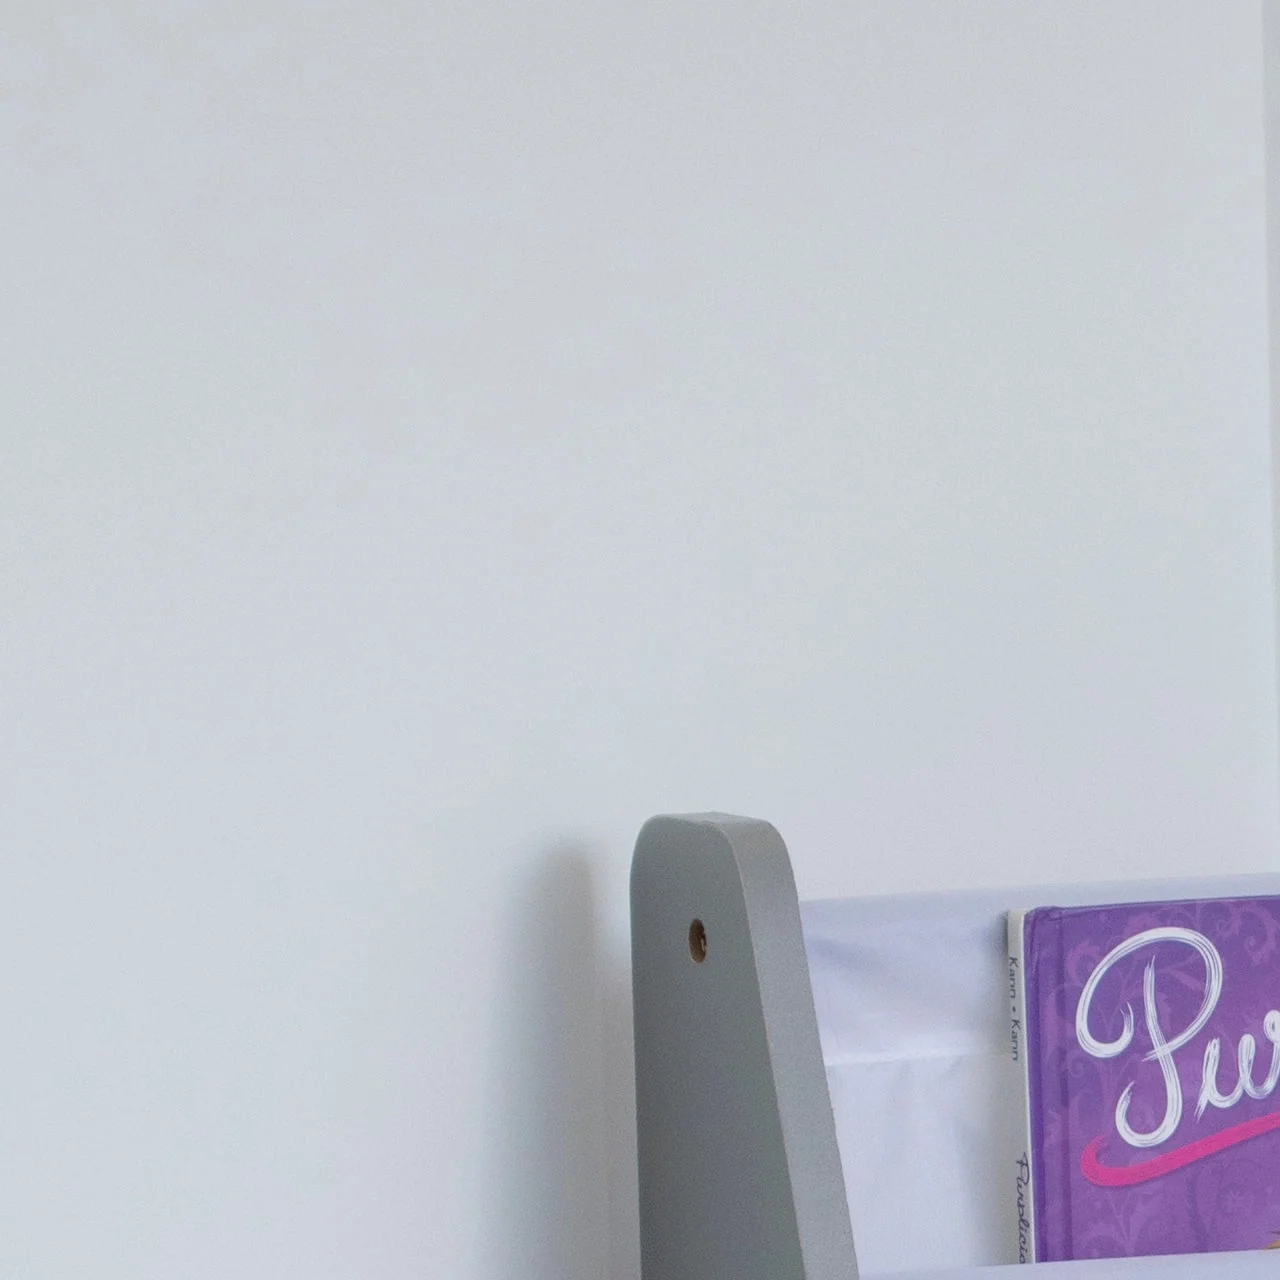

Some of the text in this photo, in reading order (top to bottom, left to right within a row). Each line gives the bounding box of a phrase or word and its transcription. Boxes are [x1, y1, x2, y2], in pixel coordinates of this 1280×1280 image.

[1009, 956, 1021, 1061] Kann Kann
[1016, 1151, 1031, 1264] Purplicio
